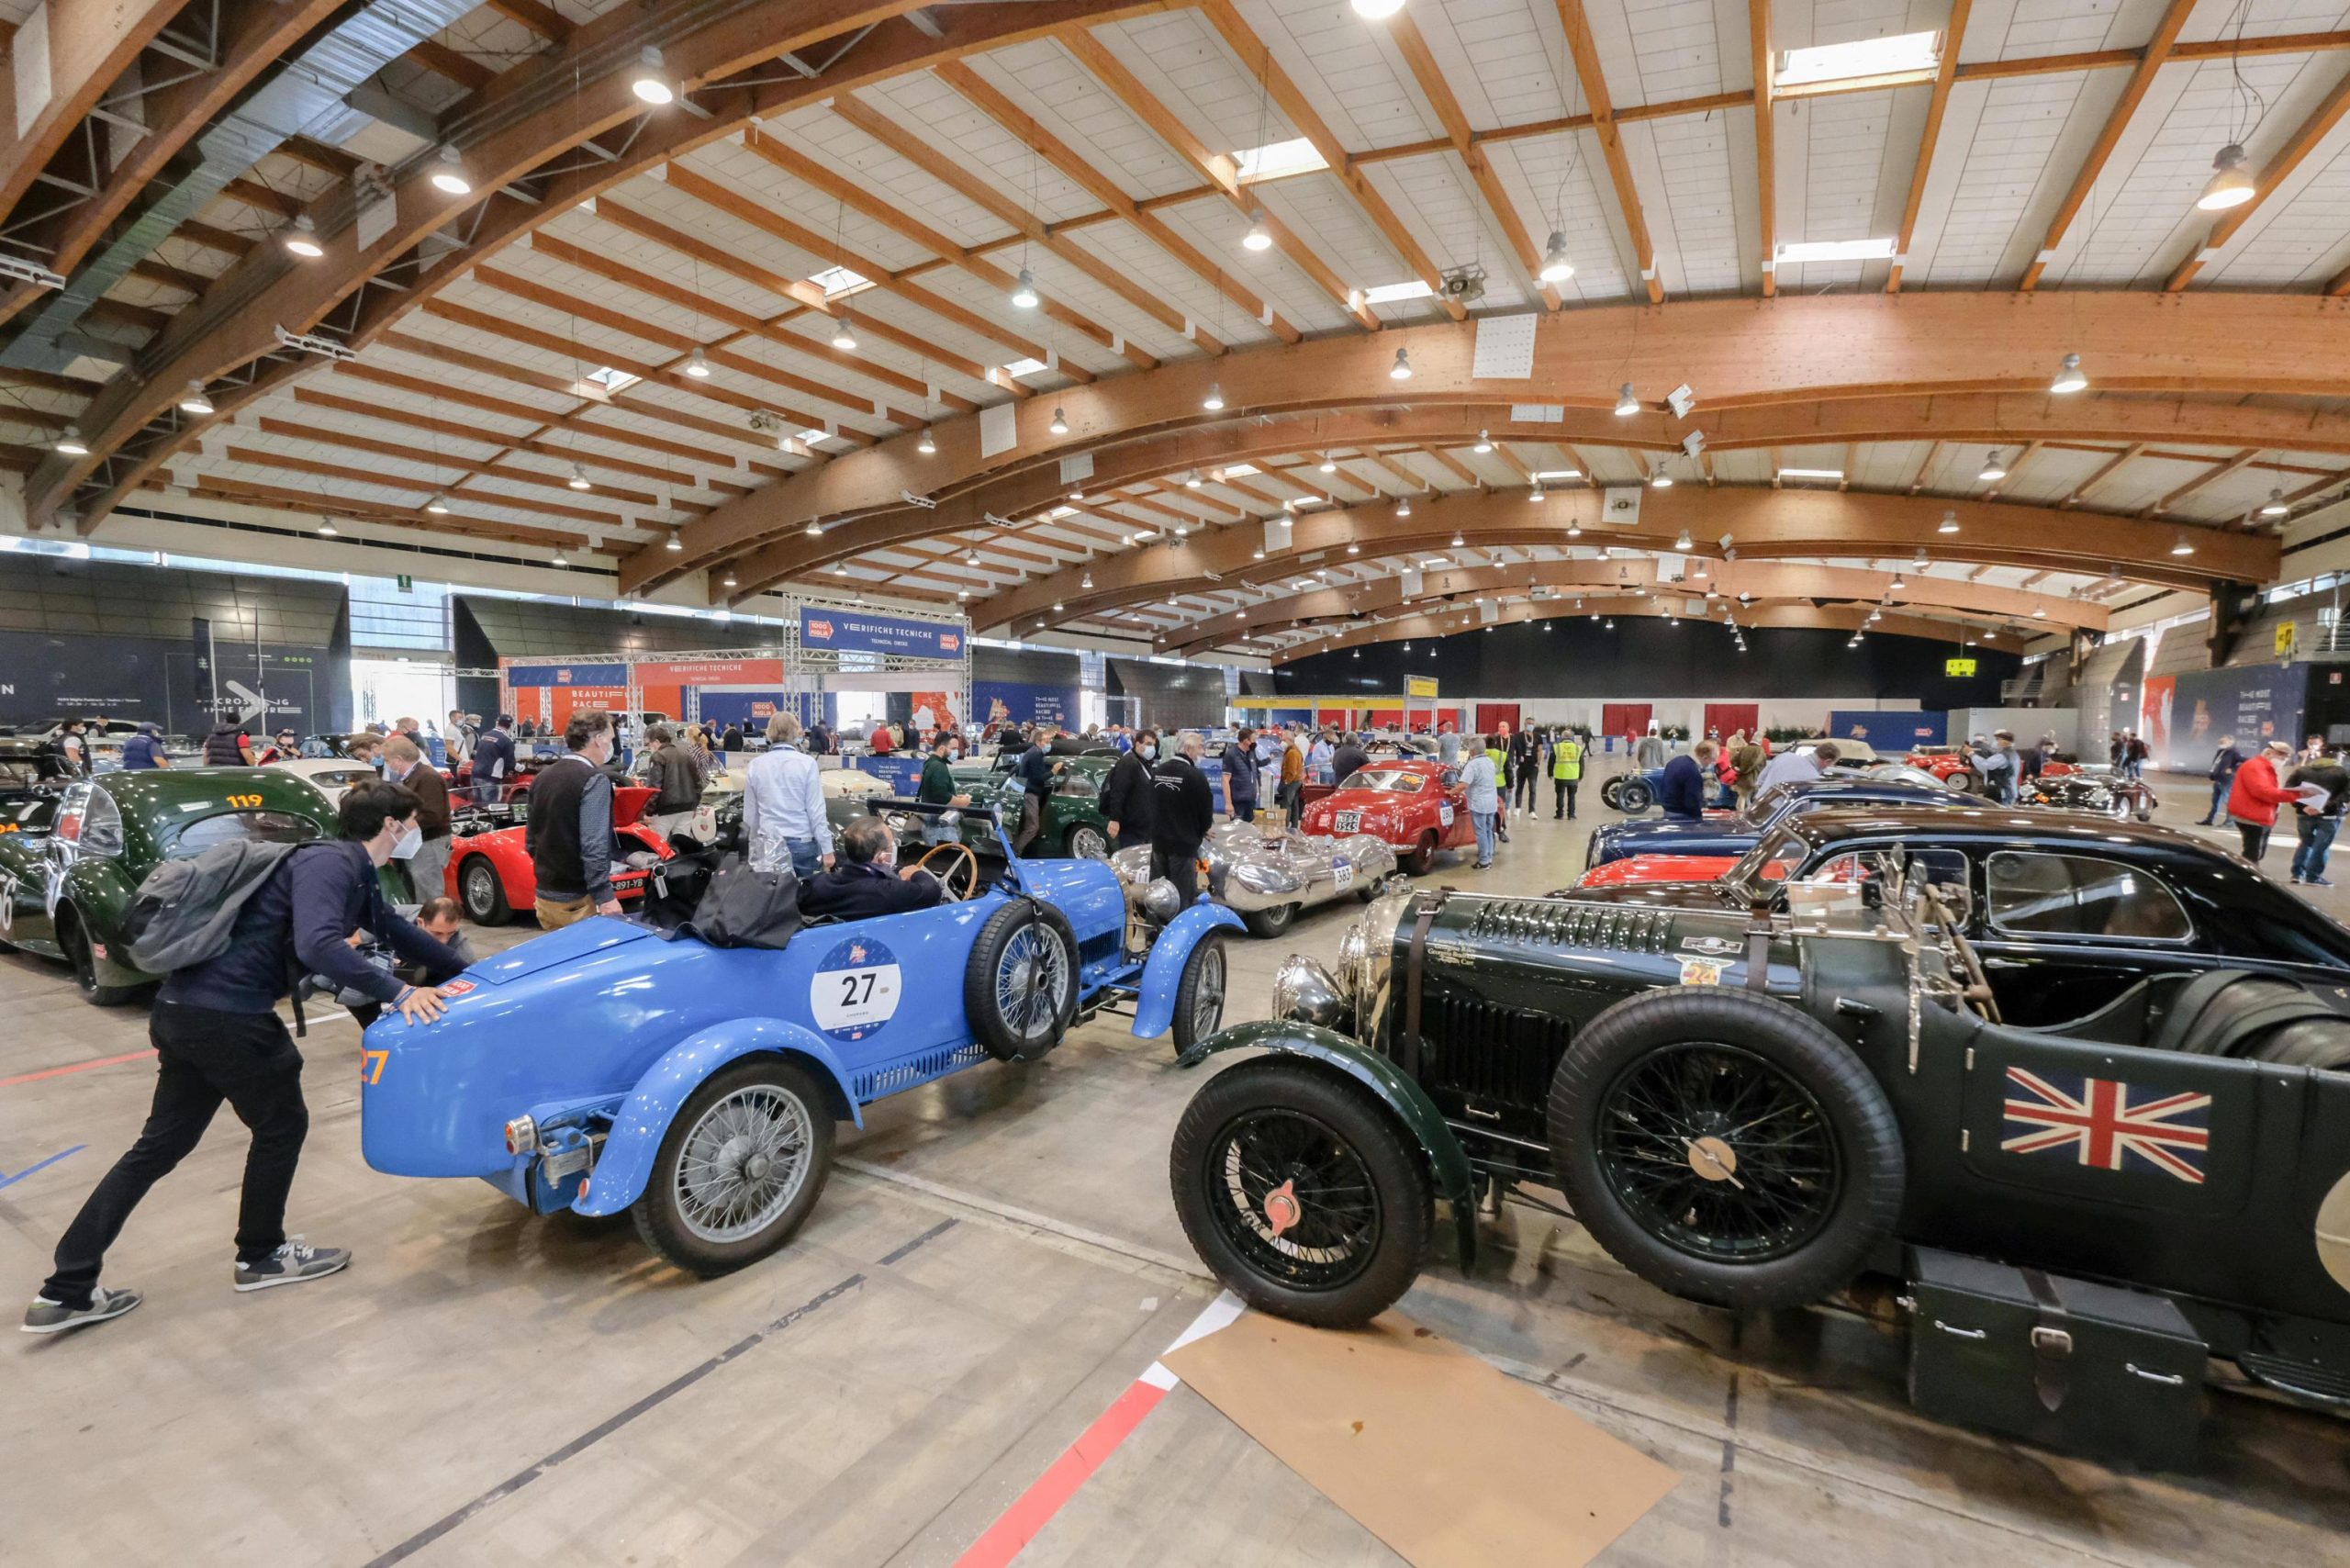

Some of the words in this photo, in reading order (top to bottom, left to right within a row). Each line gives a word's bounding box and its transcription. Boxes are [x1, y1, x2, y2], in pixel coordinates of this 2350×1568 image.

[843, 623, 892, 635] VERIFICHE
[895, 628, 933, 639] TECNICHE
[217, 698, 289, 706] CROSNG
[226, 794, 263, 808] 119
[1337, 868, 1351, 883] 383
[610, 879, 644, 890] -891-YB
[841, 972, 878, 1007] 27
[361, 1047, 389, 1086] 27
